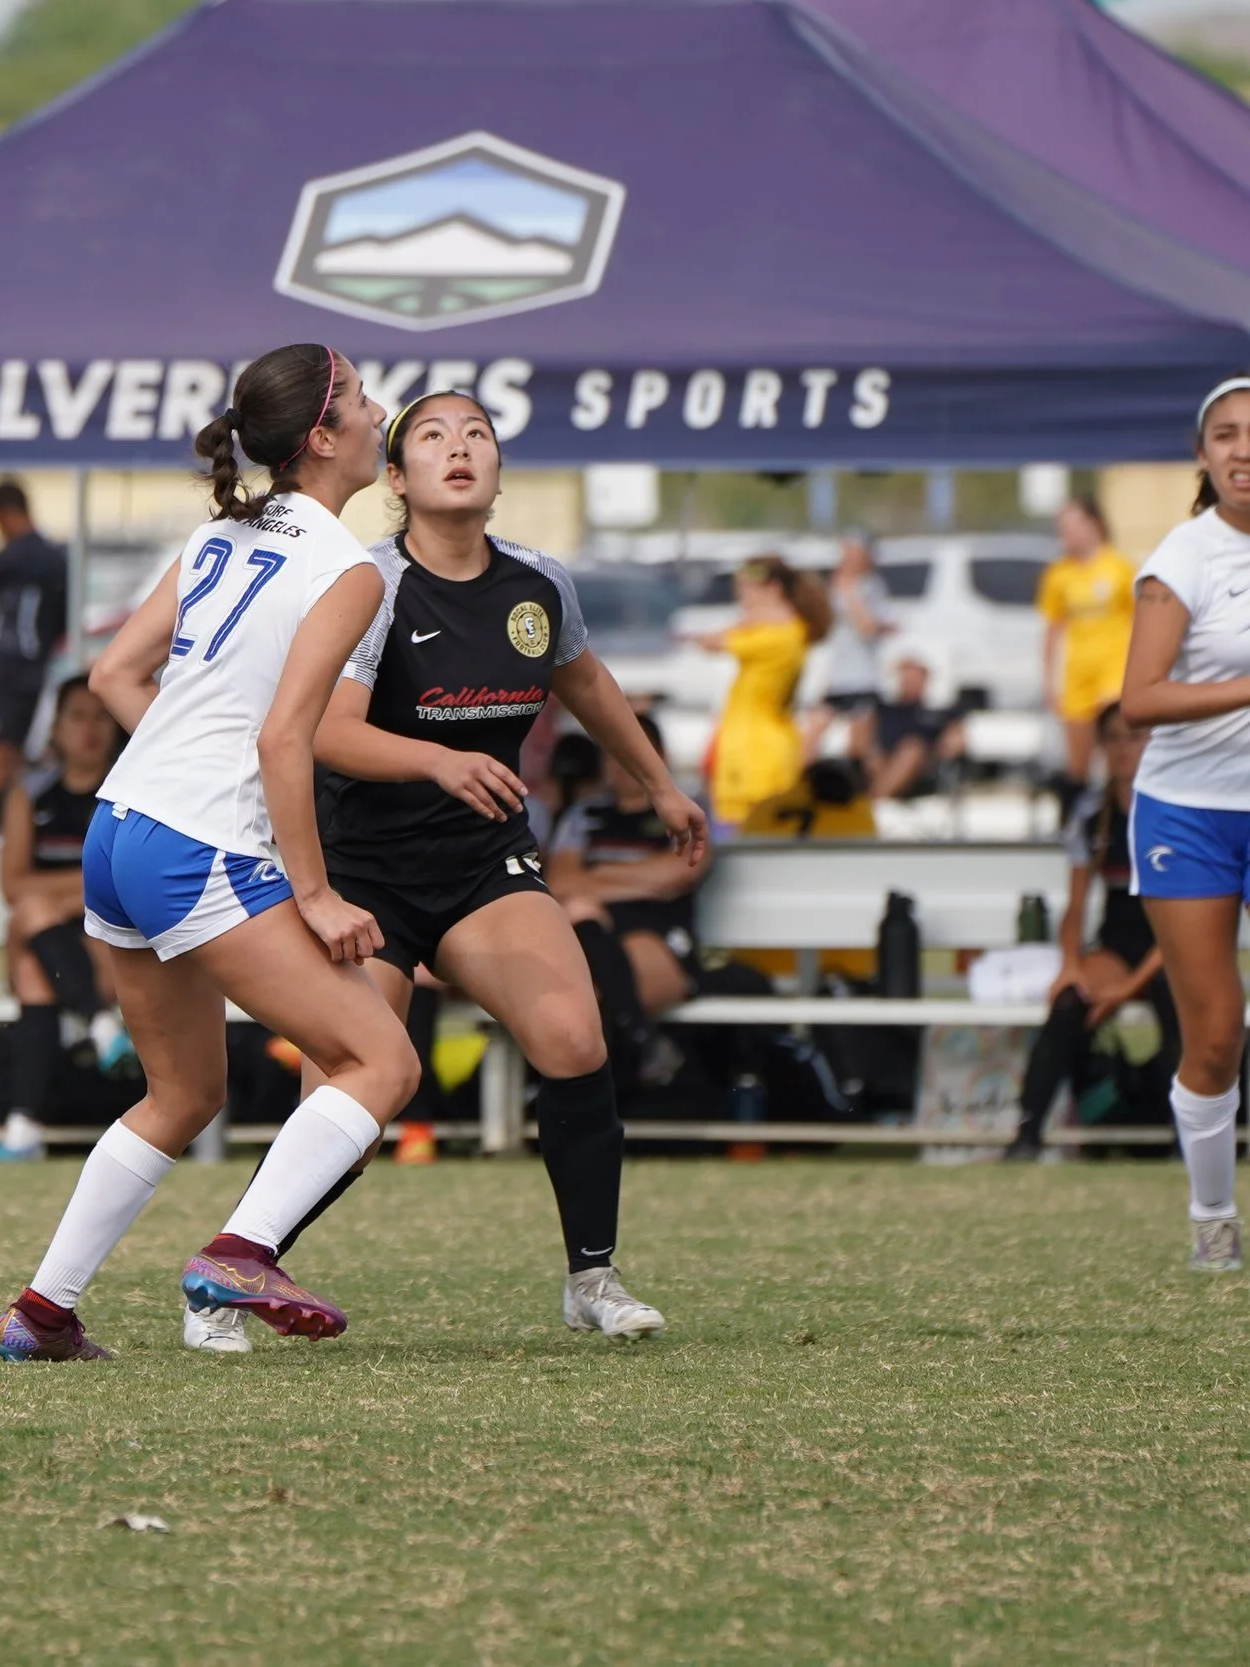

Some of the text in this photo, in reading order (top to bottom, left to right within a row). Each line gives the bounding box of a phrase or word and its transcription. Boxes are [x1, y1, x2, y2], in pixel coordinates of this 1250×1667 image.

[570, 367, 891, 431] SPORTS
[264, 504, 293, 518] SURF
[170, 537, 288, 662] 27
[419, 685, 543, 708] California
